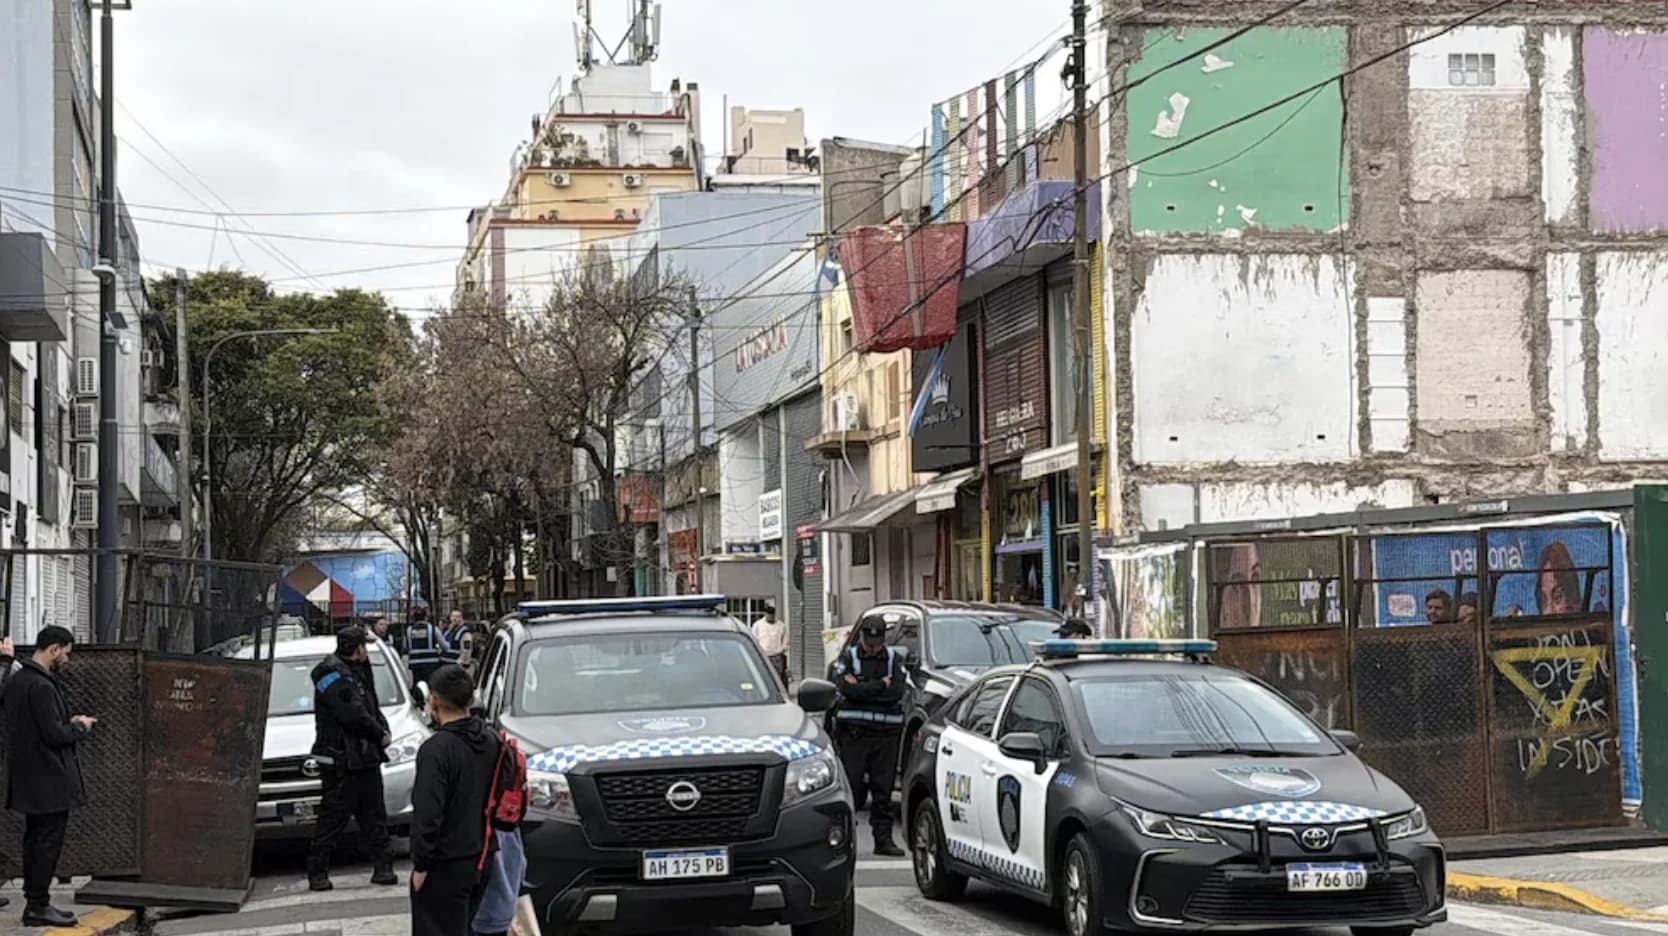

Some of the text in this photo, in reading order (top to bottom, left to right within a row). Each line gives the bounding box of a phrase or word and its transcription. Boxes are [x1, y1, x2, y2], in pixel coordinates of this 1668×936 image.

[1451, 536, 1526, 577] peronal
[649, 857, 725, 875] AH 175 PB
[1291, 873, 1309, 888] AF
[1314, 872, 1341, 887] 766
